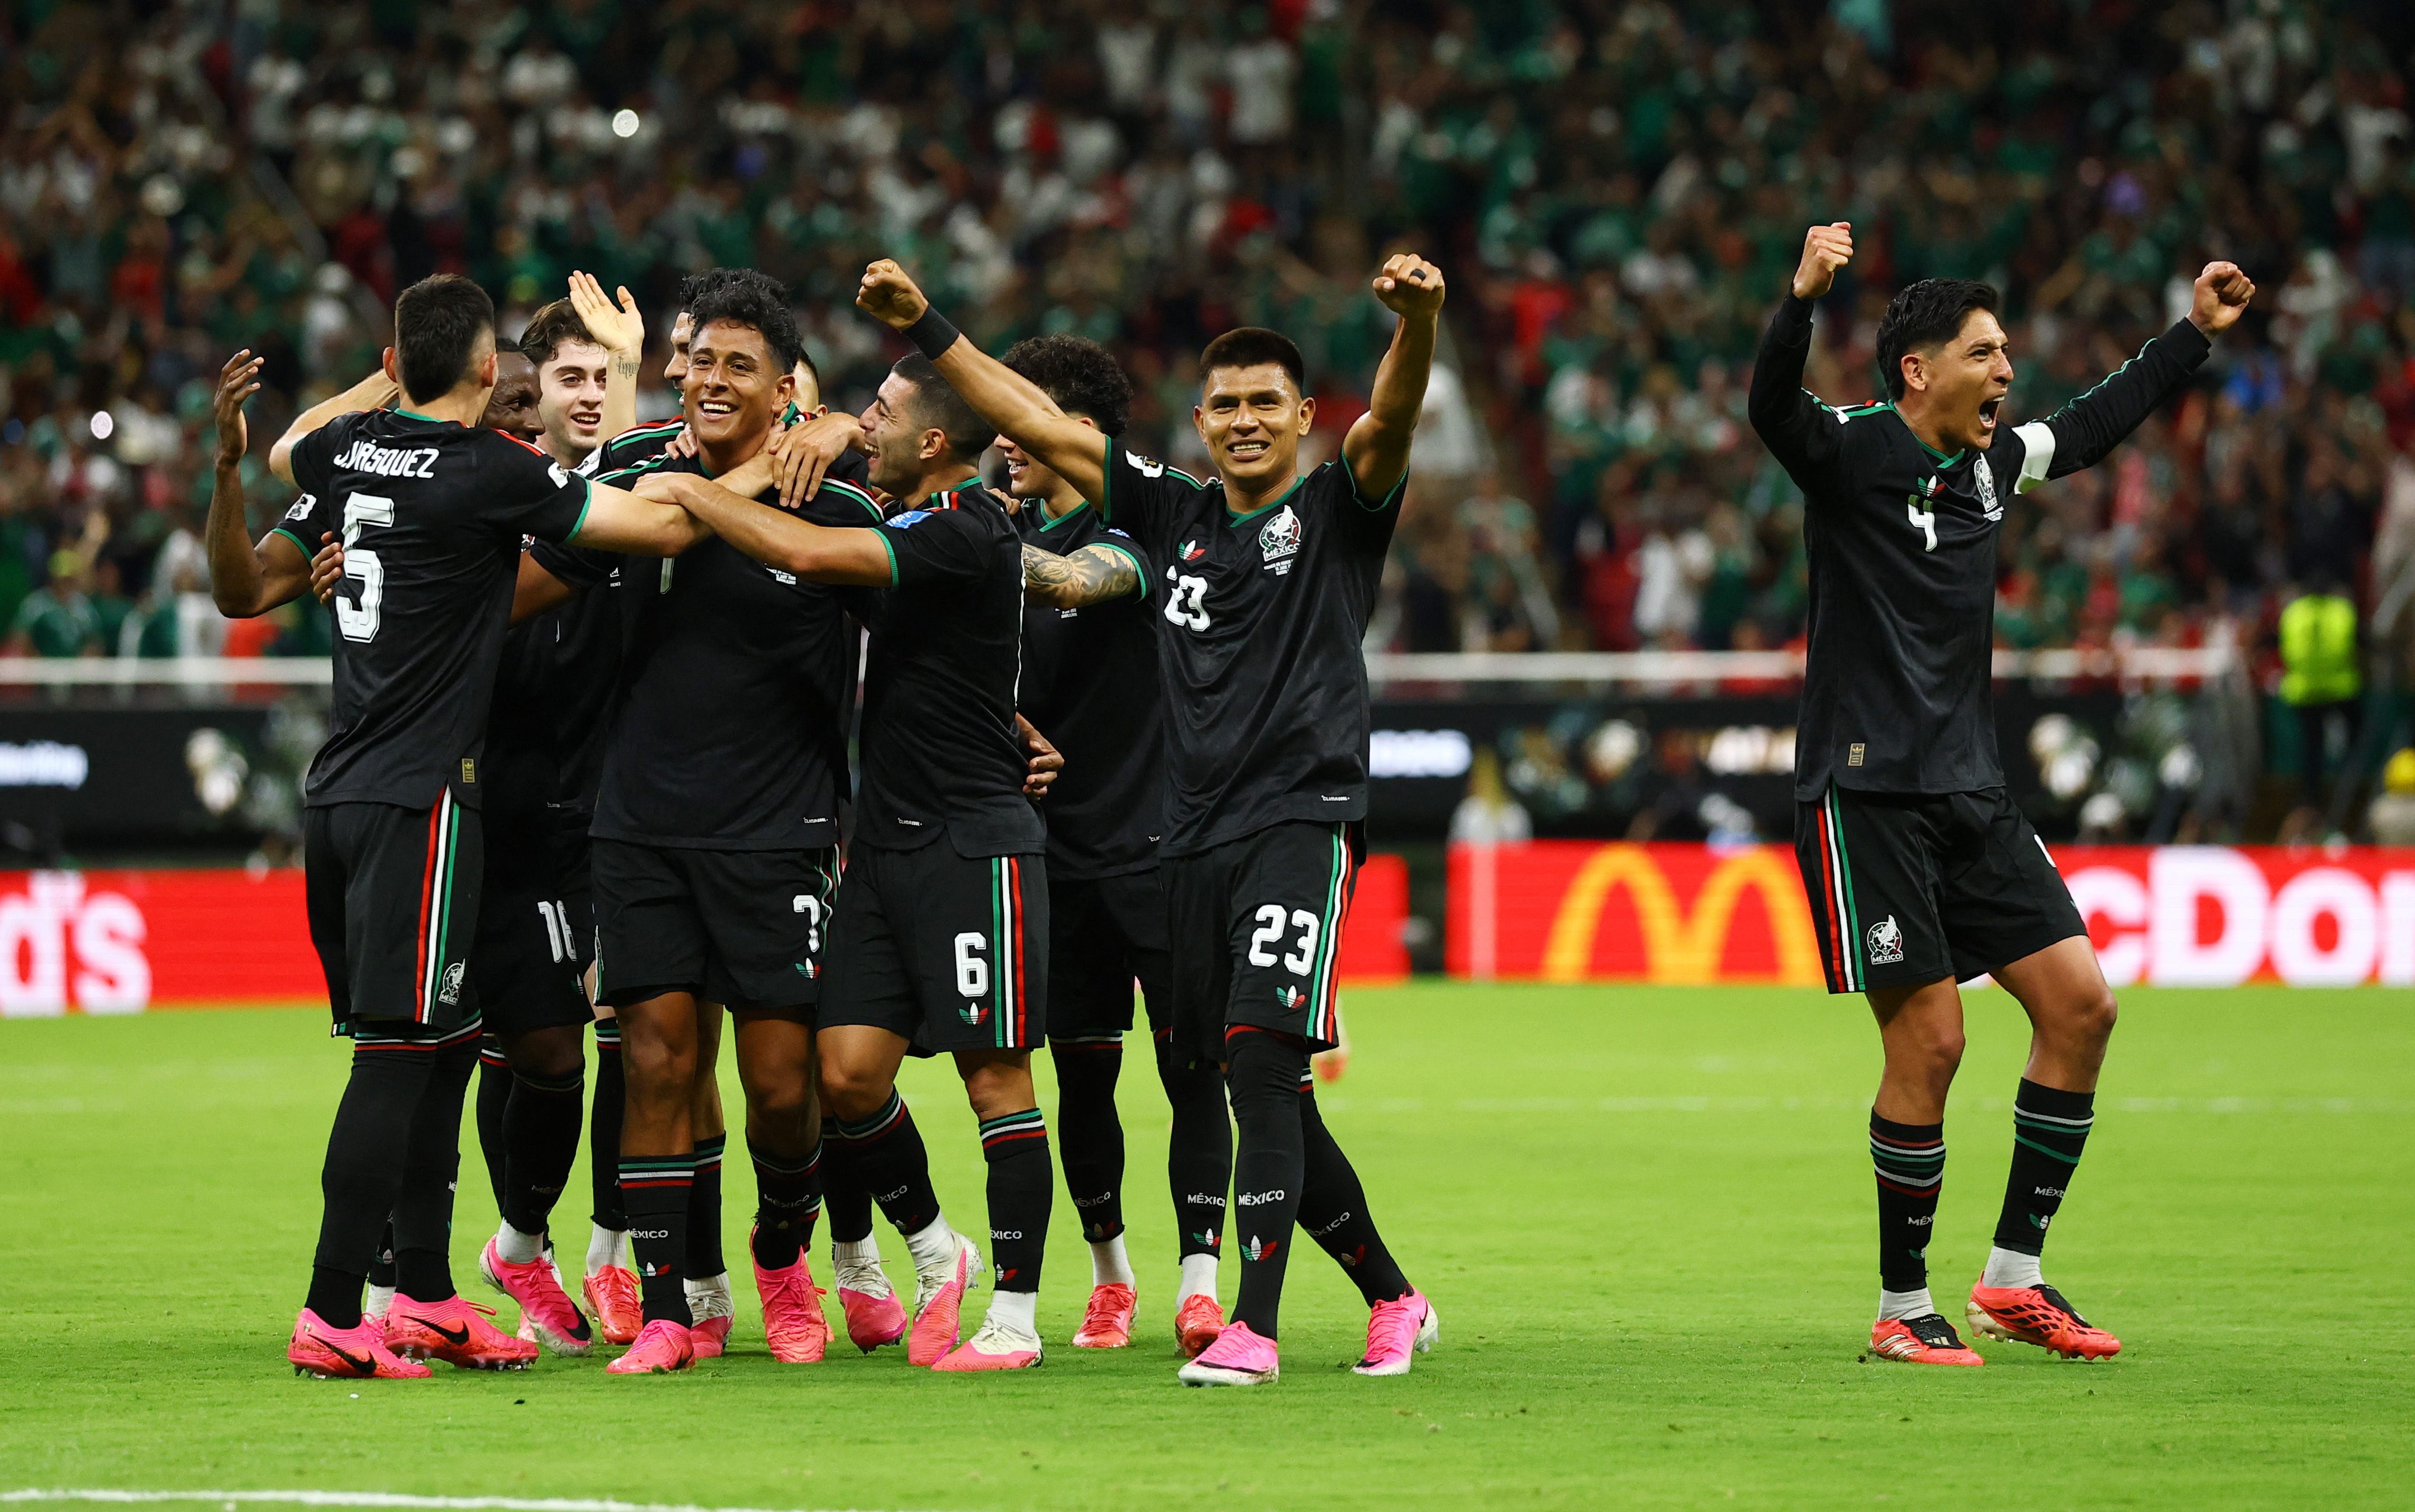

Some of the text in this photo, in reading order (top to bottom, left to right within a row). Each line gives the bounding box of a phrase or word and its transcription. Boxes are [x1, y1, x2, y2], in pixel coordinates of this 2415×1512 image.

[1908, 494, 1938, 551] 4
[336, 491, 394, 644] 5
[792, 895, 820, 953] 7
[1248, 904, 1320, 977] 23
[954, 931, 989, 997] 6
[1872, 953, 1901, 963] MÉXICO
[1238, 1190, 1285, 1206] MÉXICO
